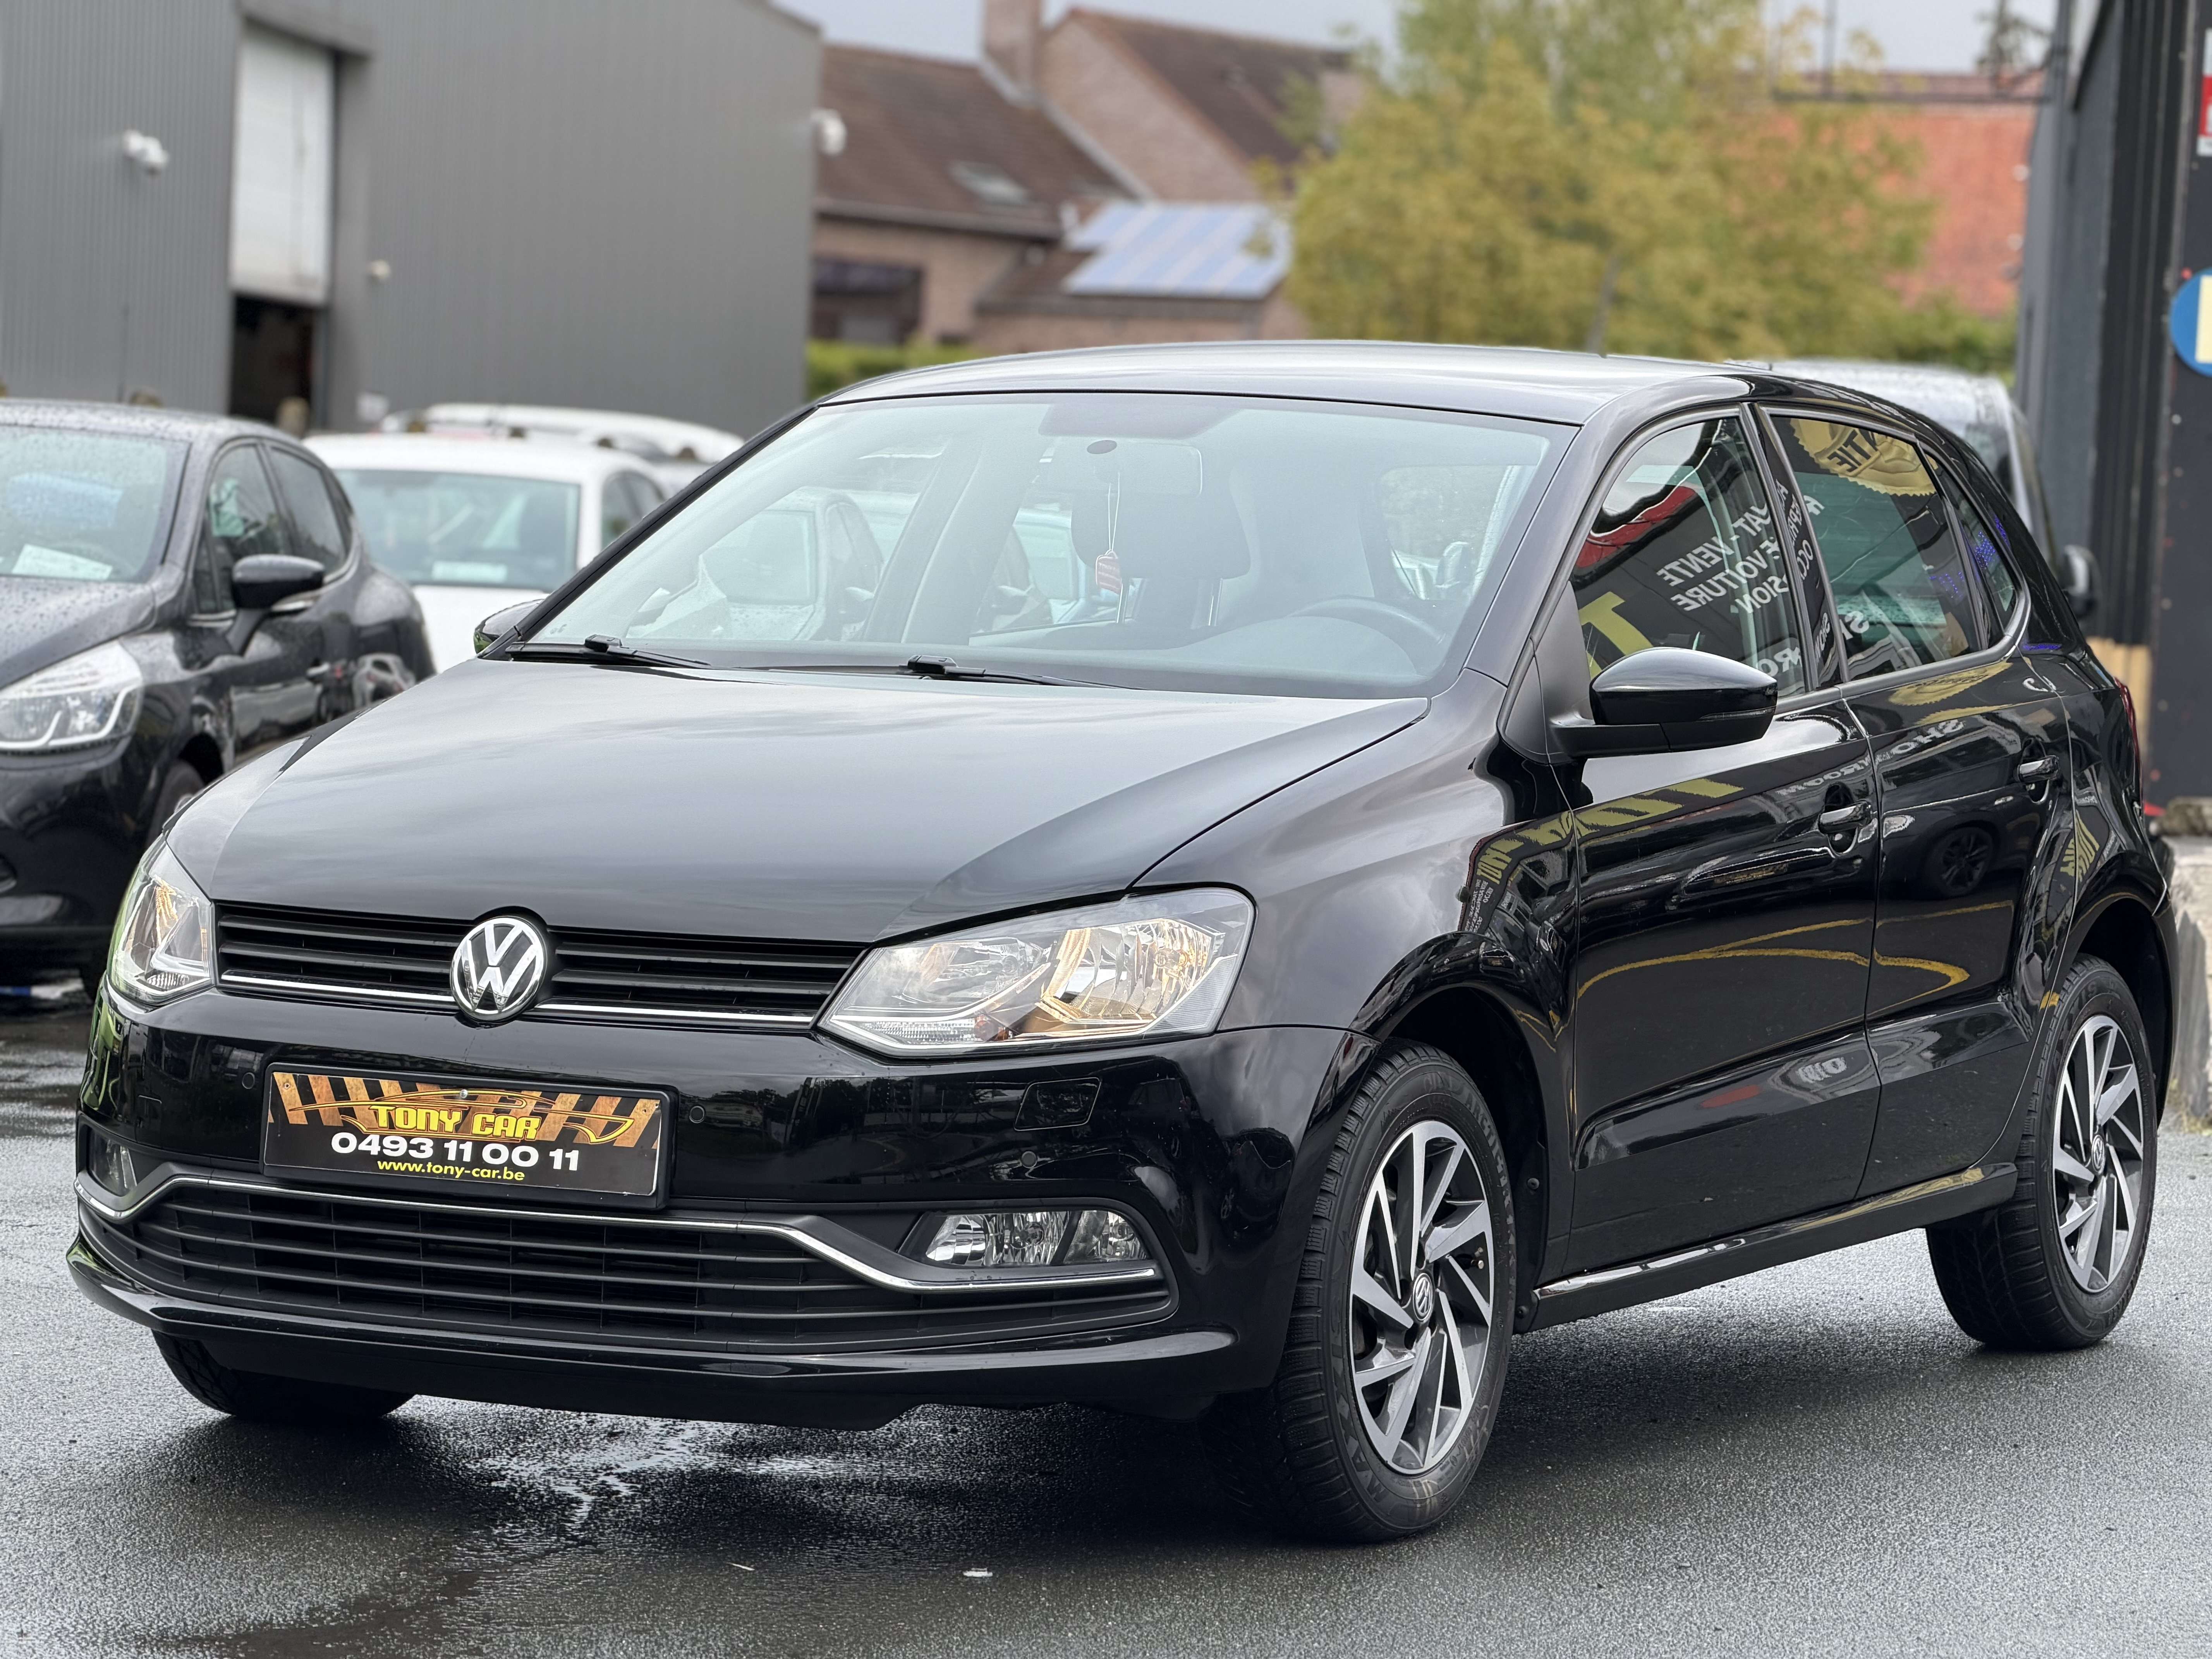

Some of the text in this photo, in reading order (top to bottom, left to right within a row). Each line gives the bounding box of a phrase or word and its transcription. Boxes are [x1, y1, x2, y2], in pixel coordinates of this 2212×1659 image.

[369, 1105, 541, 1140] TONY CAR
[331, 1132, 579, 1171] 0493 11 00 11
[377, 1161, 525, 1181] www.tony-car.be
